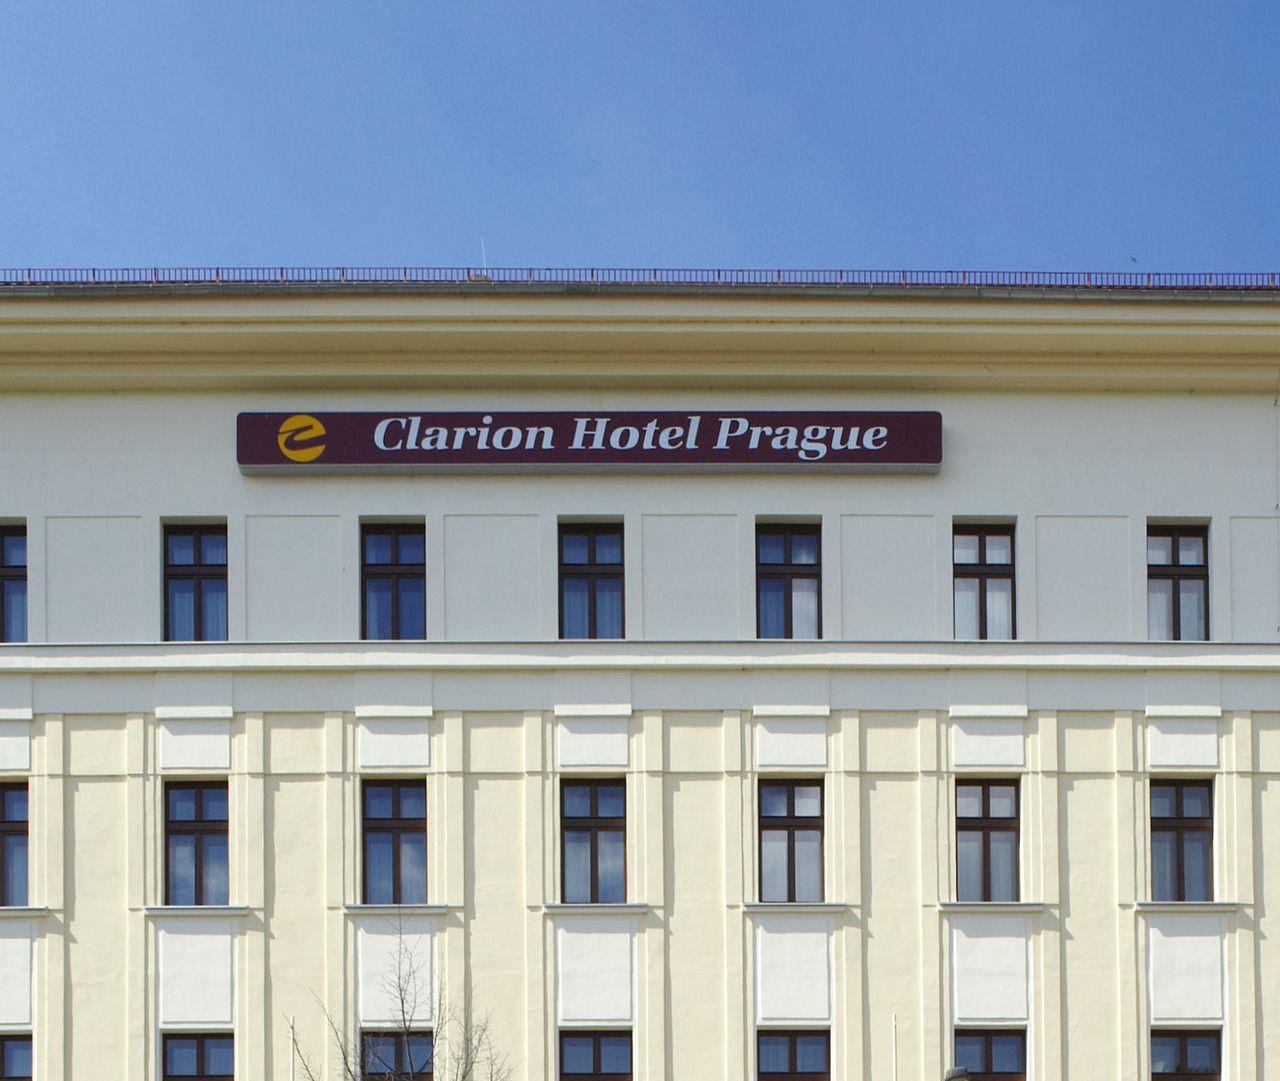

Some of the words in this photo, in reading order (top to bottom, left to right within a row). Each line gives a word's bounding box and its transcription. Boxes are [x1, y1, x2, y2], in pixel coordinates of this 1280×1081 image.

[373, 416, 555, 450] Clarion
[568, 416, 700, 450] Hotel
[713, 416, 888, 461] Prague
